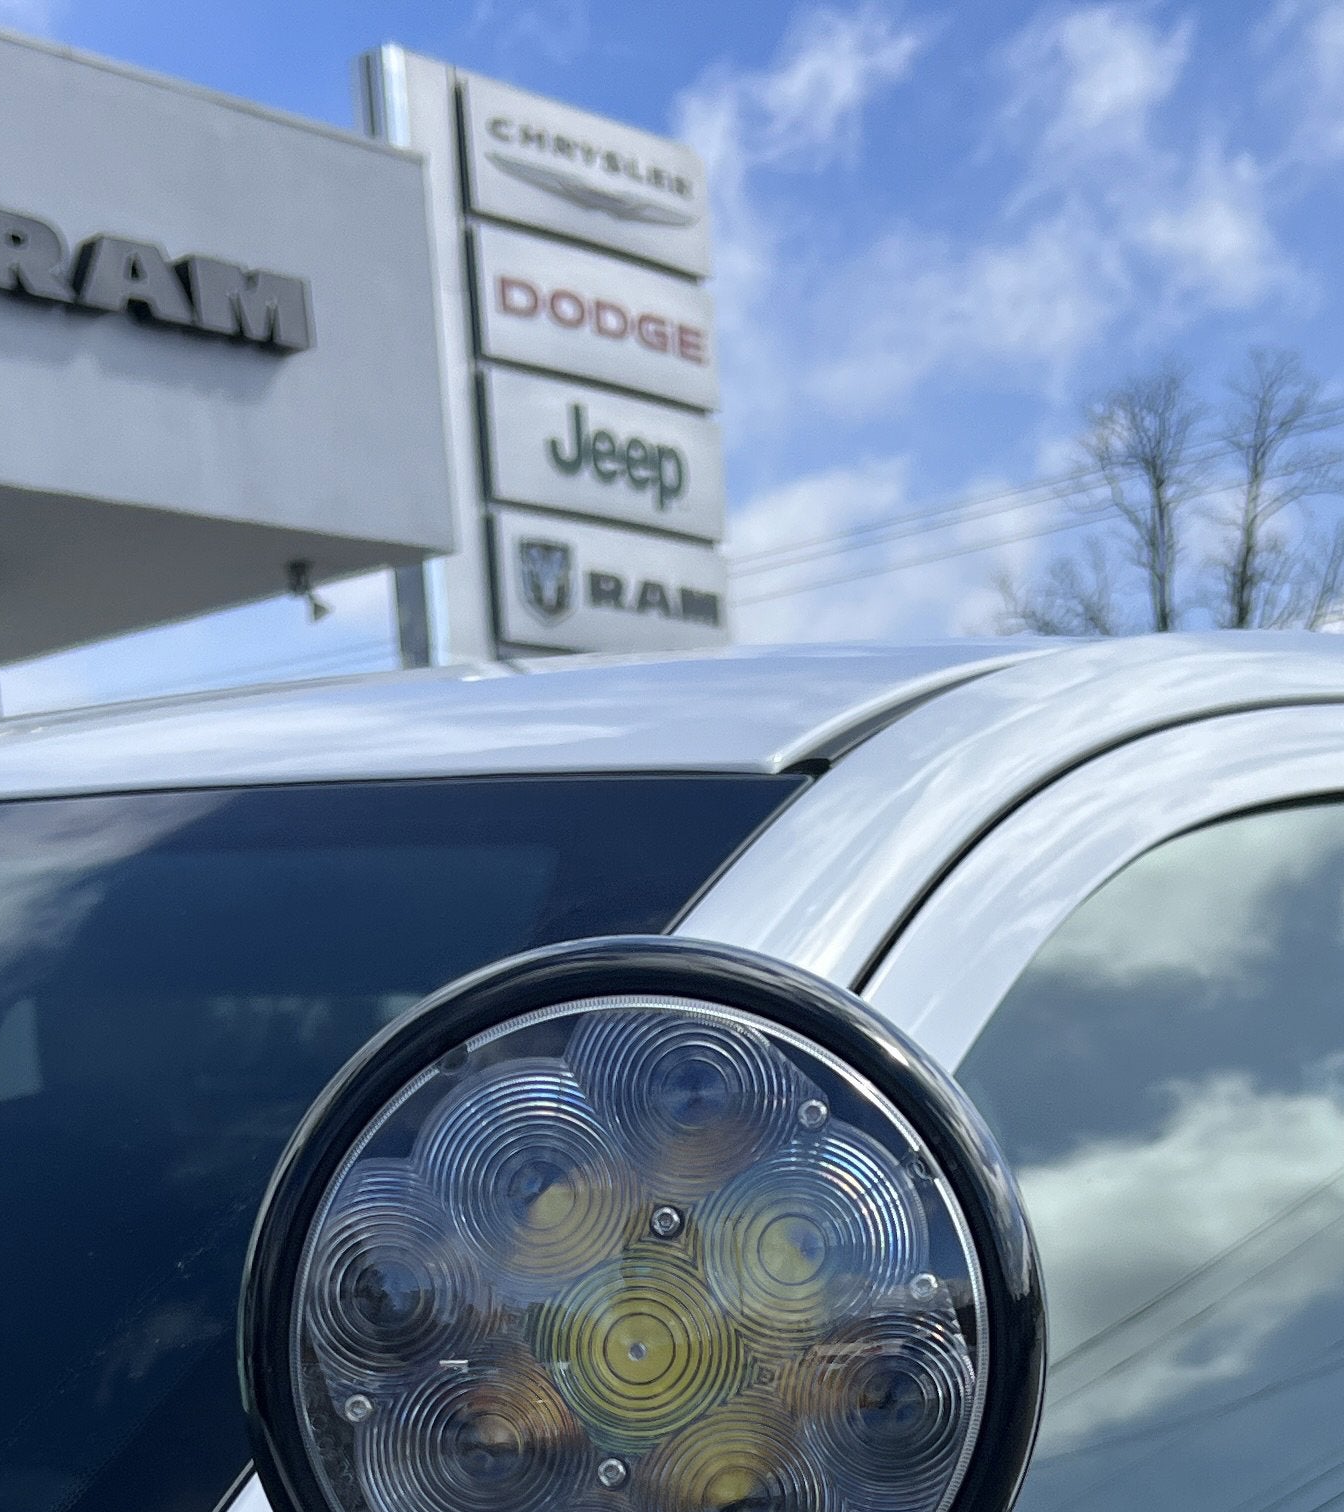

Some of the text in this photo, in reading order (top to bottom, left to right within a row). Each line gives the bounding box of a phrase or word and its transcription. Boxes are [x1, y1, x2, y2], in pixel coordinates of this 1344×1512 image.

[486, 116, 695, 199] CHRYSLER
[497, 276, 708, 364] DODGE
[549, 403, 689, 508] Jeep
[588, 569, 720, 625] RAM
